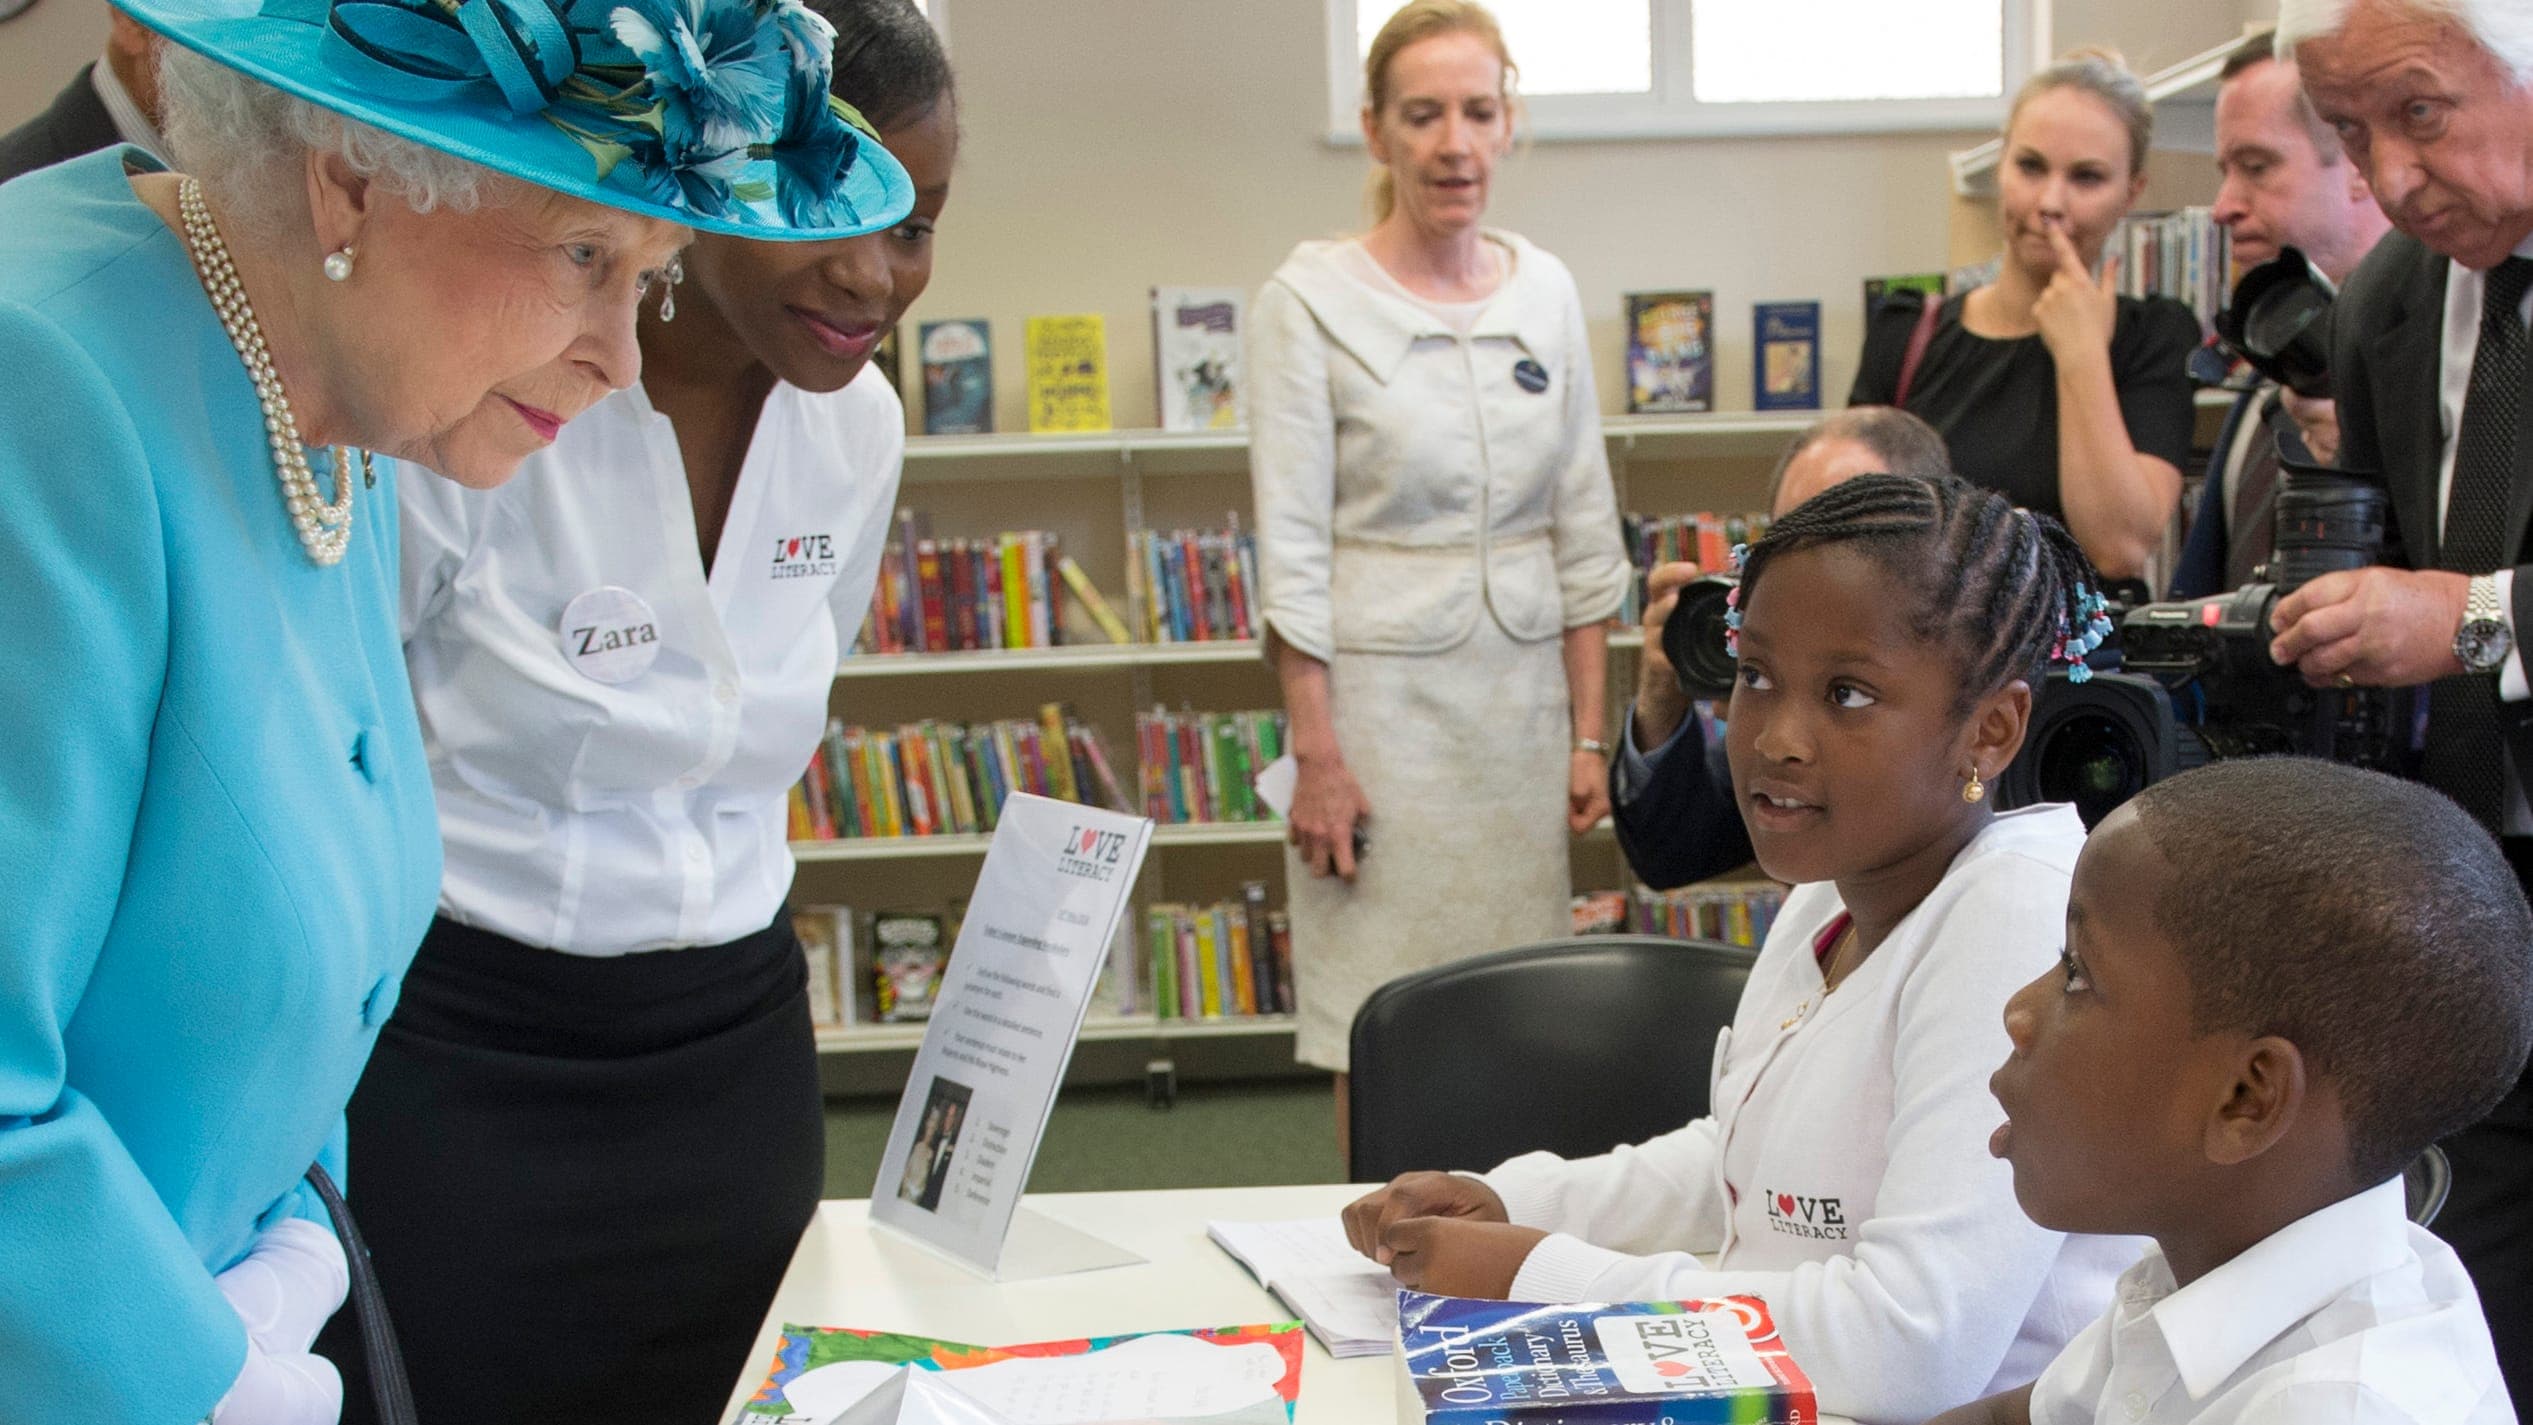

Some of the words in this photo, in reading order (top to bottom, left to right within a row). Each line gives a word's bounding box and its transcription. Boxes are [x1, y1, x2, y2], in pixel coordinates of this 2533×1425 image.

[771, 562, 837, 579] LITERACY
[572, 622, 658, 656] Zara
[1057, 857, 1115, 882] LITERACY
[1770, 1217, 1848, 1240] LITERACY
[1418, 1324, 1492, 1403] Oxford
[1525, 1332, 1570, 1398] Dictionary
[1558, 1319, 1605, 1390] Thesaurus
[1683, 1318, 1739, 1387] LITERACY
